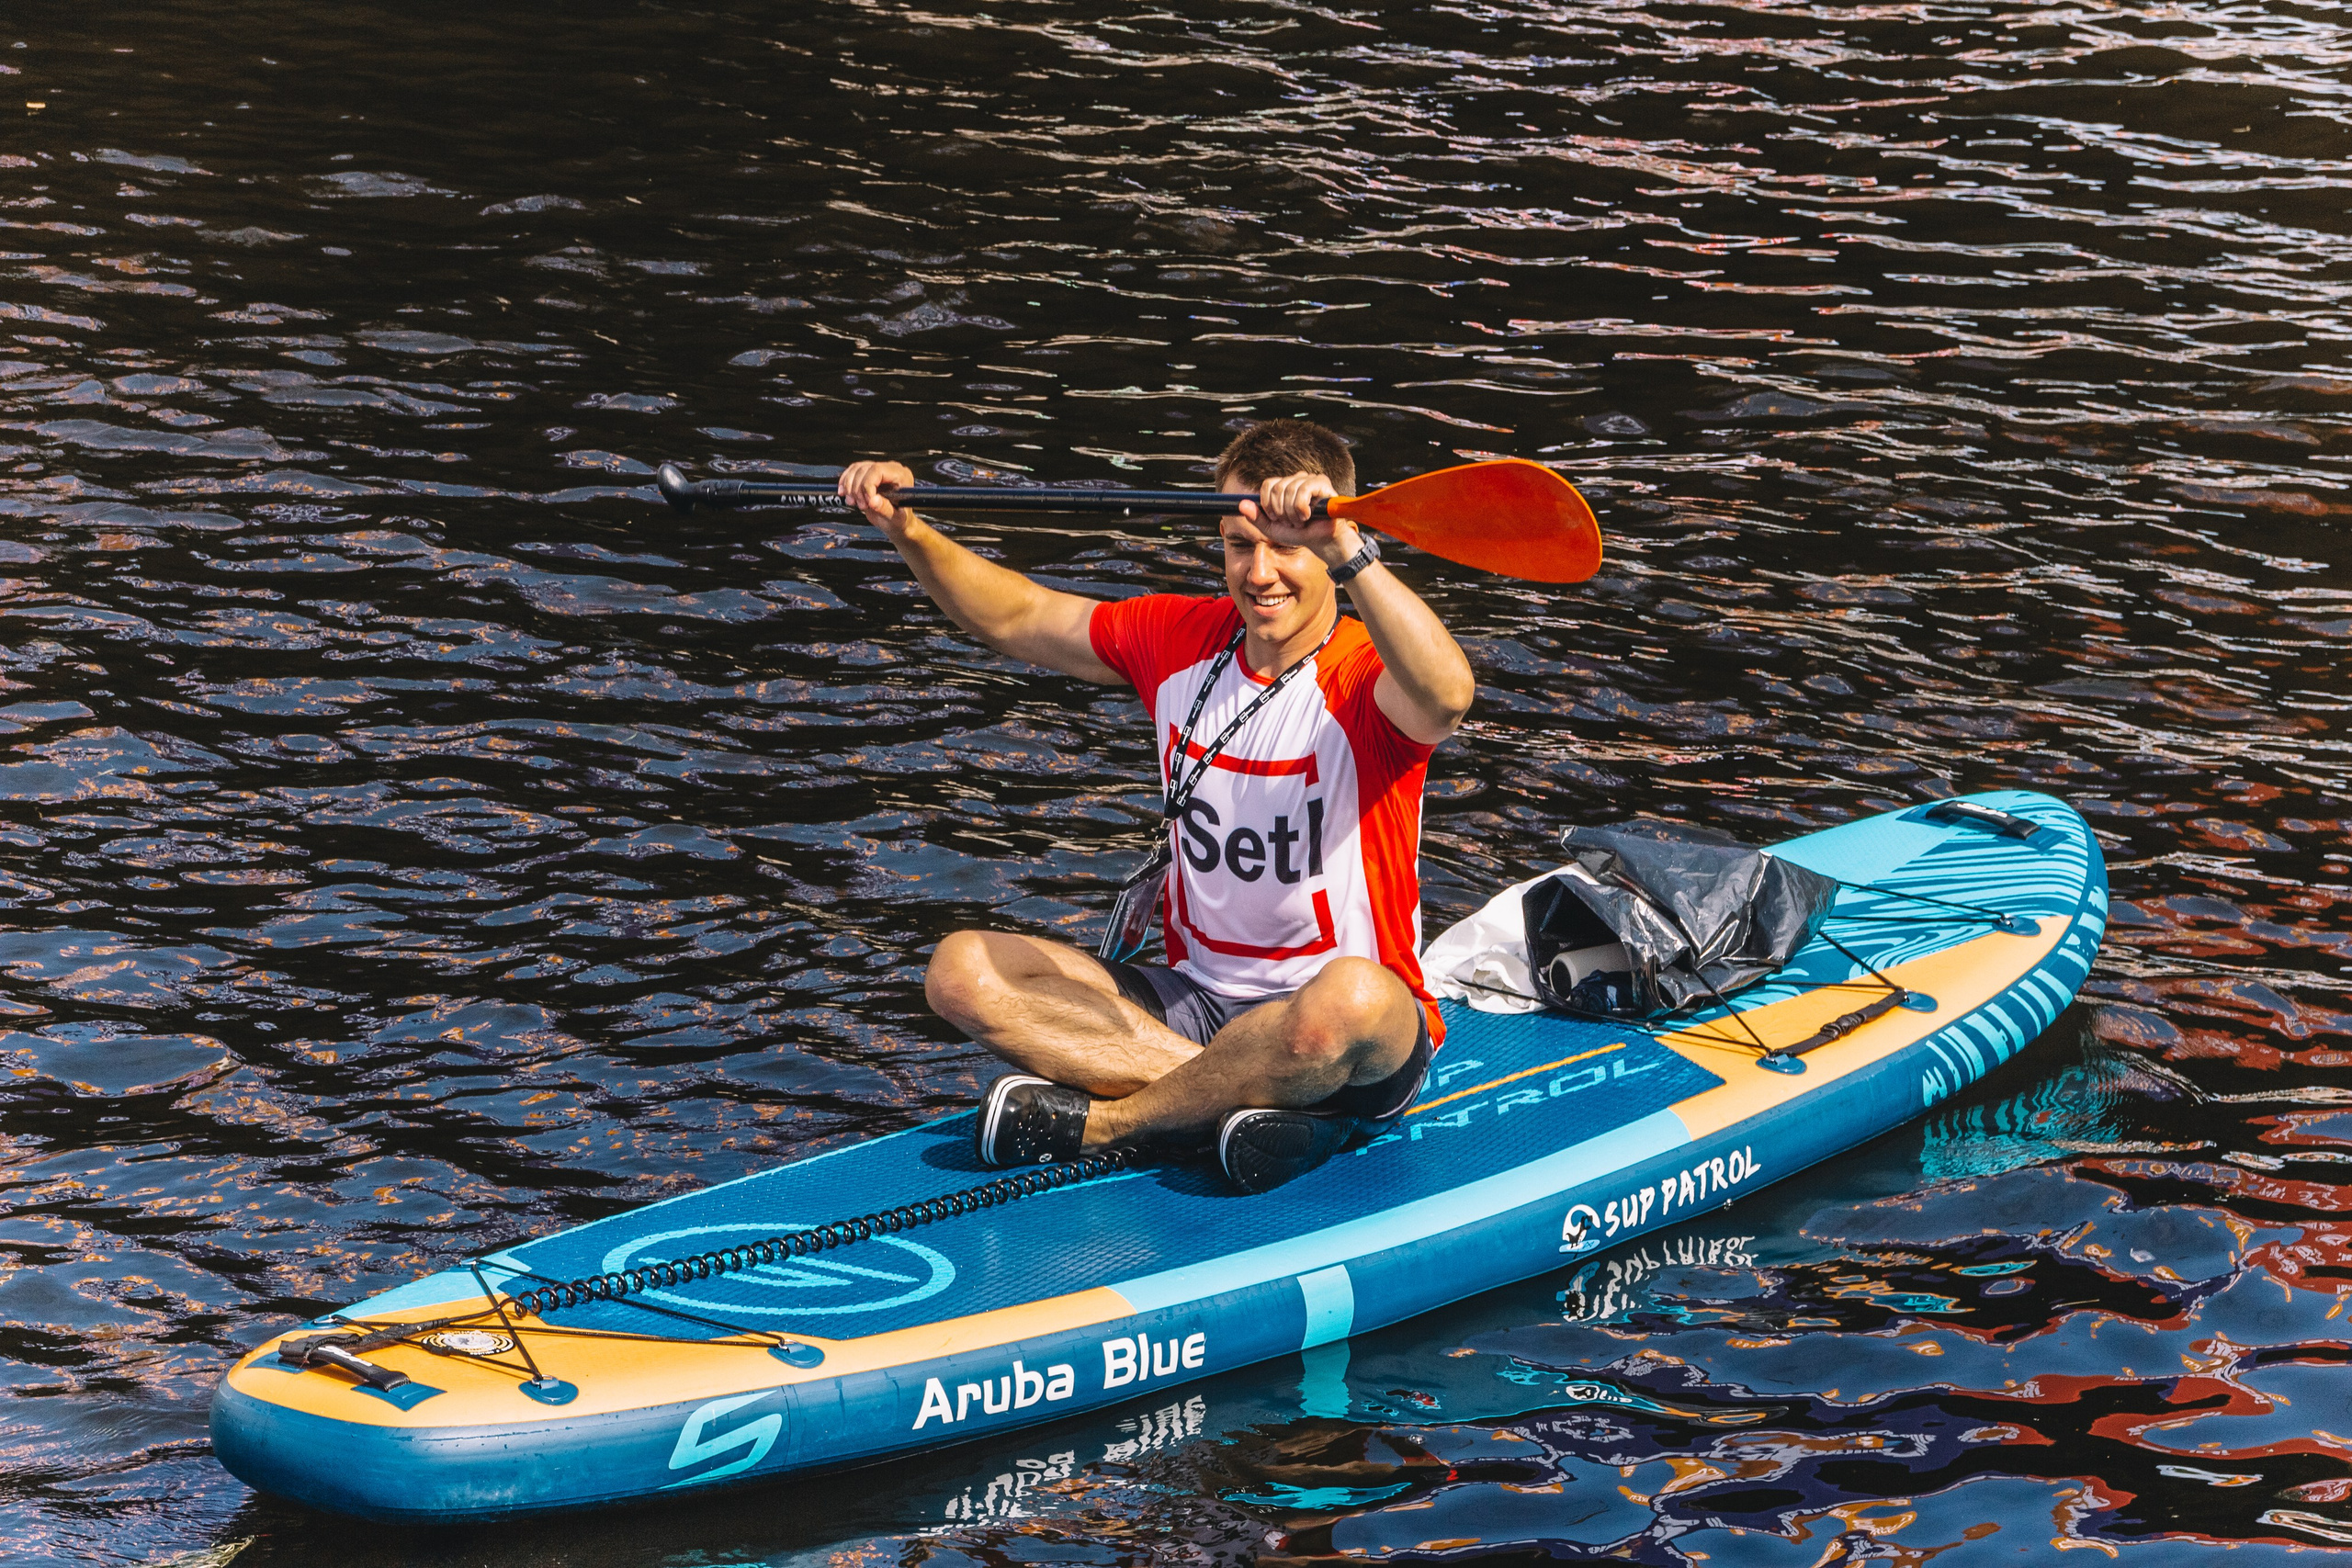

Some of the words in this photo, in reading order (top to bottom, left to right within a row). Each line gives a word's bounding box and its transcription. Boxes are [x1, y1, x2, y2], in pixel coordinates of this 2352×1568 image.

[1181, 796, 1324, 885] Setl
[1604, 1186, 1656, 1238] SUP
[1660, 1145, 1761, 1216] PATROL
[912, 1360, 1075, 1430] Aruba
[1102, 1332, 1205, 1390] Blue
